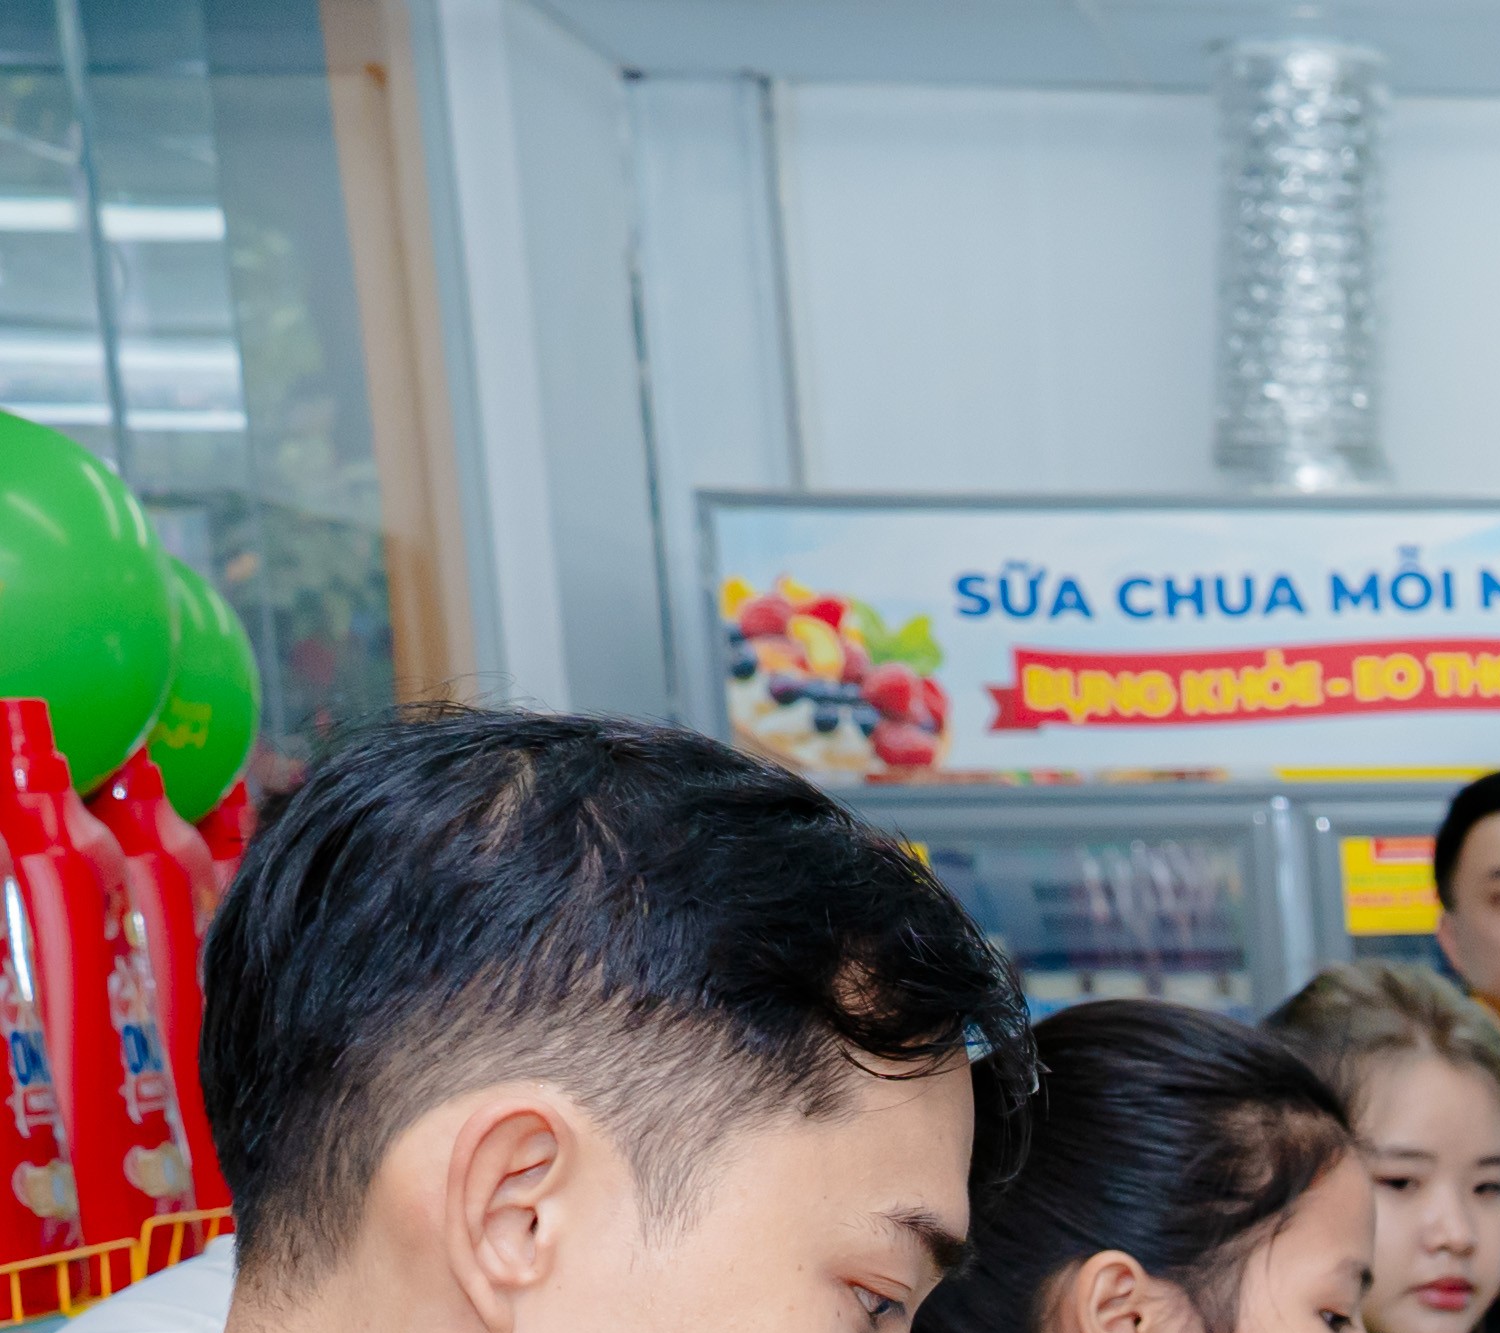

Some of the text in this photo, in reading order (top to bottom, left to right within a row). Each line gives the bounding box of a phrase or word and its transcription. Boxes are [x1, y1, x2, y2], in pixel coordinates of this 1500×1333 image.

[955, 560, 1093, 619] SỮA
[1117, 576, 1306, 618] CHUA
[1329, 545, 1454, 613] MỖI
[1022, 664, 1177, 725] BỤNG
[1180, 649, 1322, 717] KHỎE
[1352, 653, 1424, 701] EO
